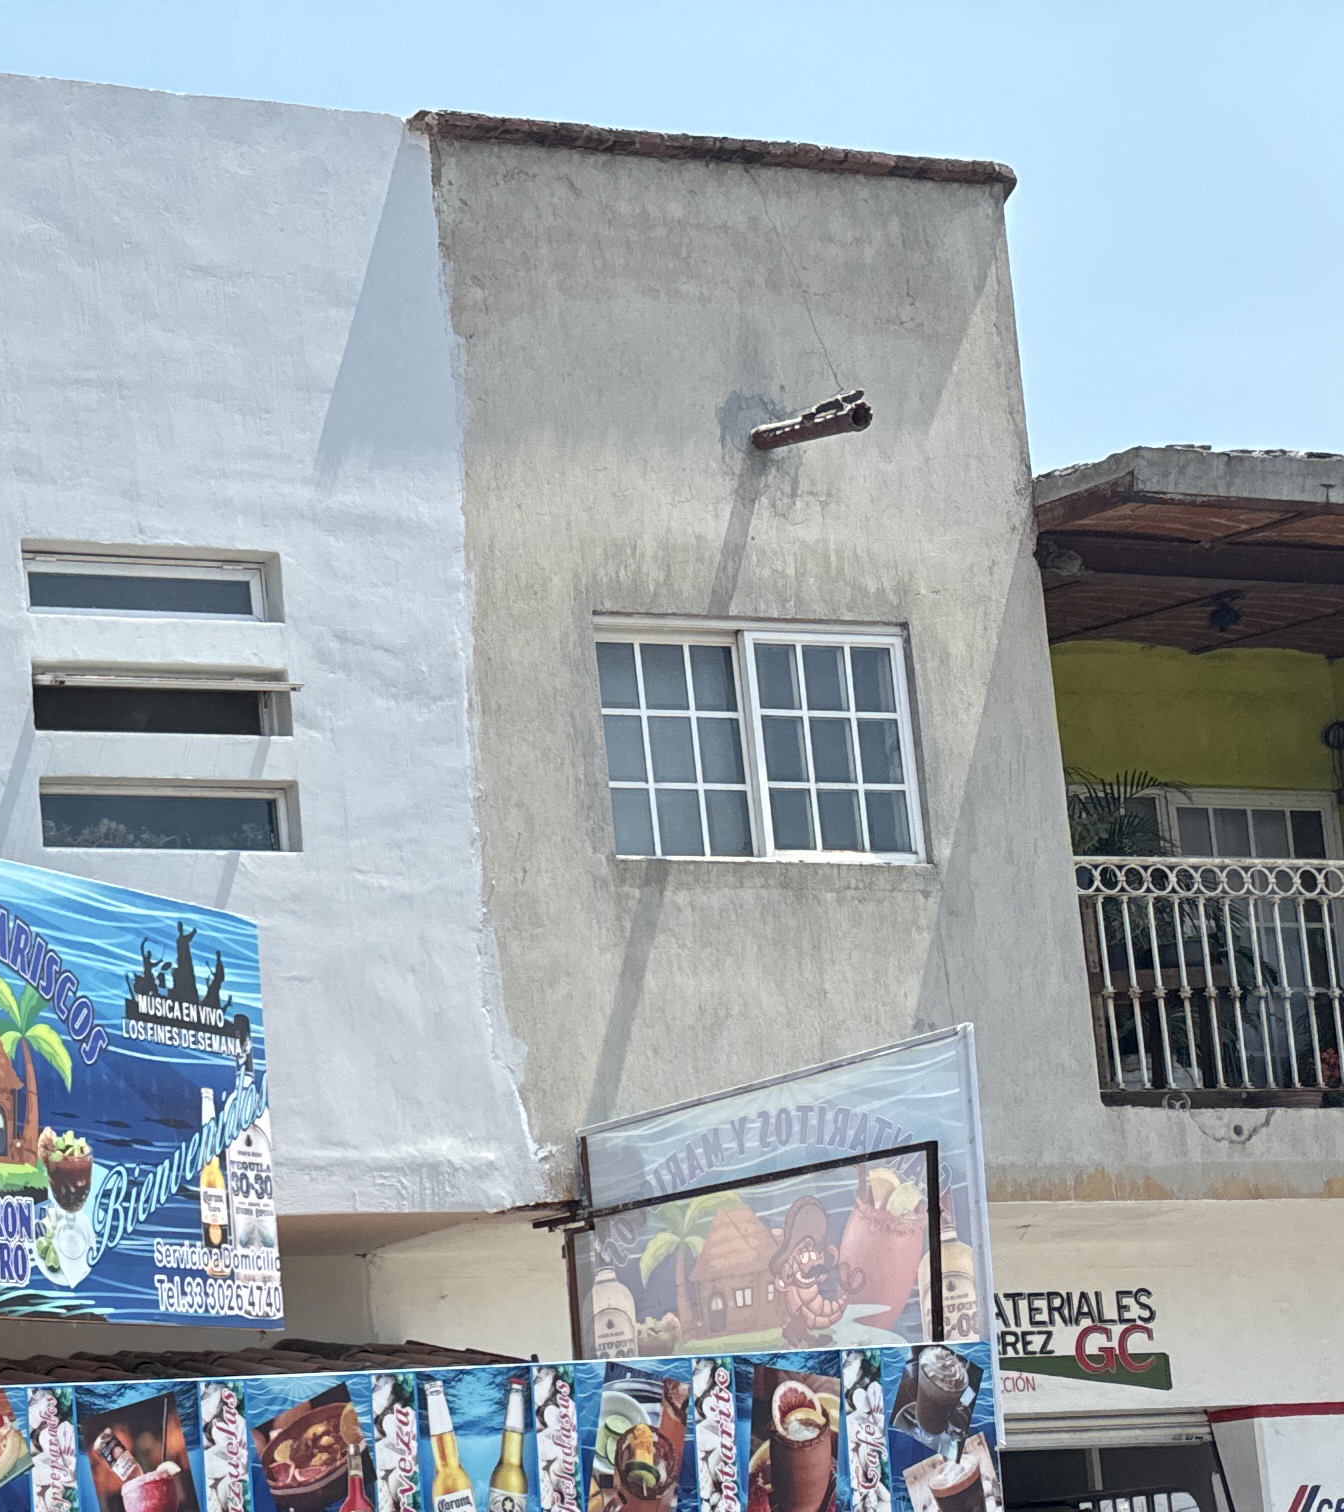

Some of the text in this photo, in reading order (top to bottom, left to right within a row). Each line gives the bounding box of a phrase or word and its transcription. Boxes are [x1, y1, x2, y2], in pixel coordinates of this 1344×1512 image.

[138, 991, 224, 1028] MÚSICA EN VIVO
[122, 1018, 242, 1056] LOS FINES DE SEMANA
[88, 1063, 267, 1267] Bienvenidos
[154, 1239, 210, 1269] Servicio
[212, 1250, 221, 1269] a
[207, 1280, 244, 1315] 3026
[245, 1284, 283, 1317] 4740
[1075, 1324, 1157, 1374] GC
[856, 1423, 888, 1492] Café
